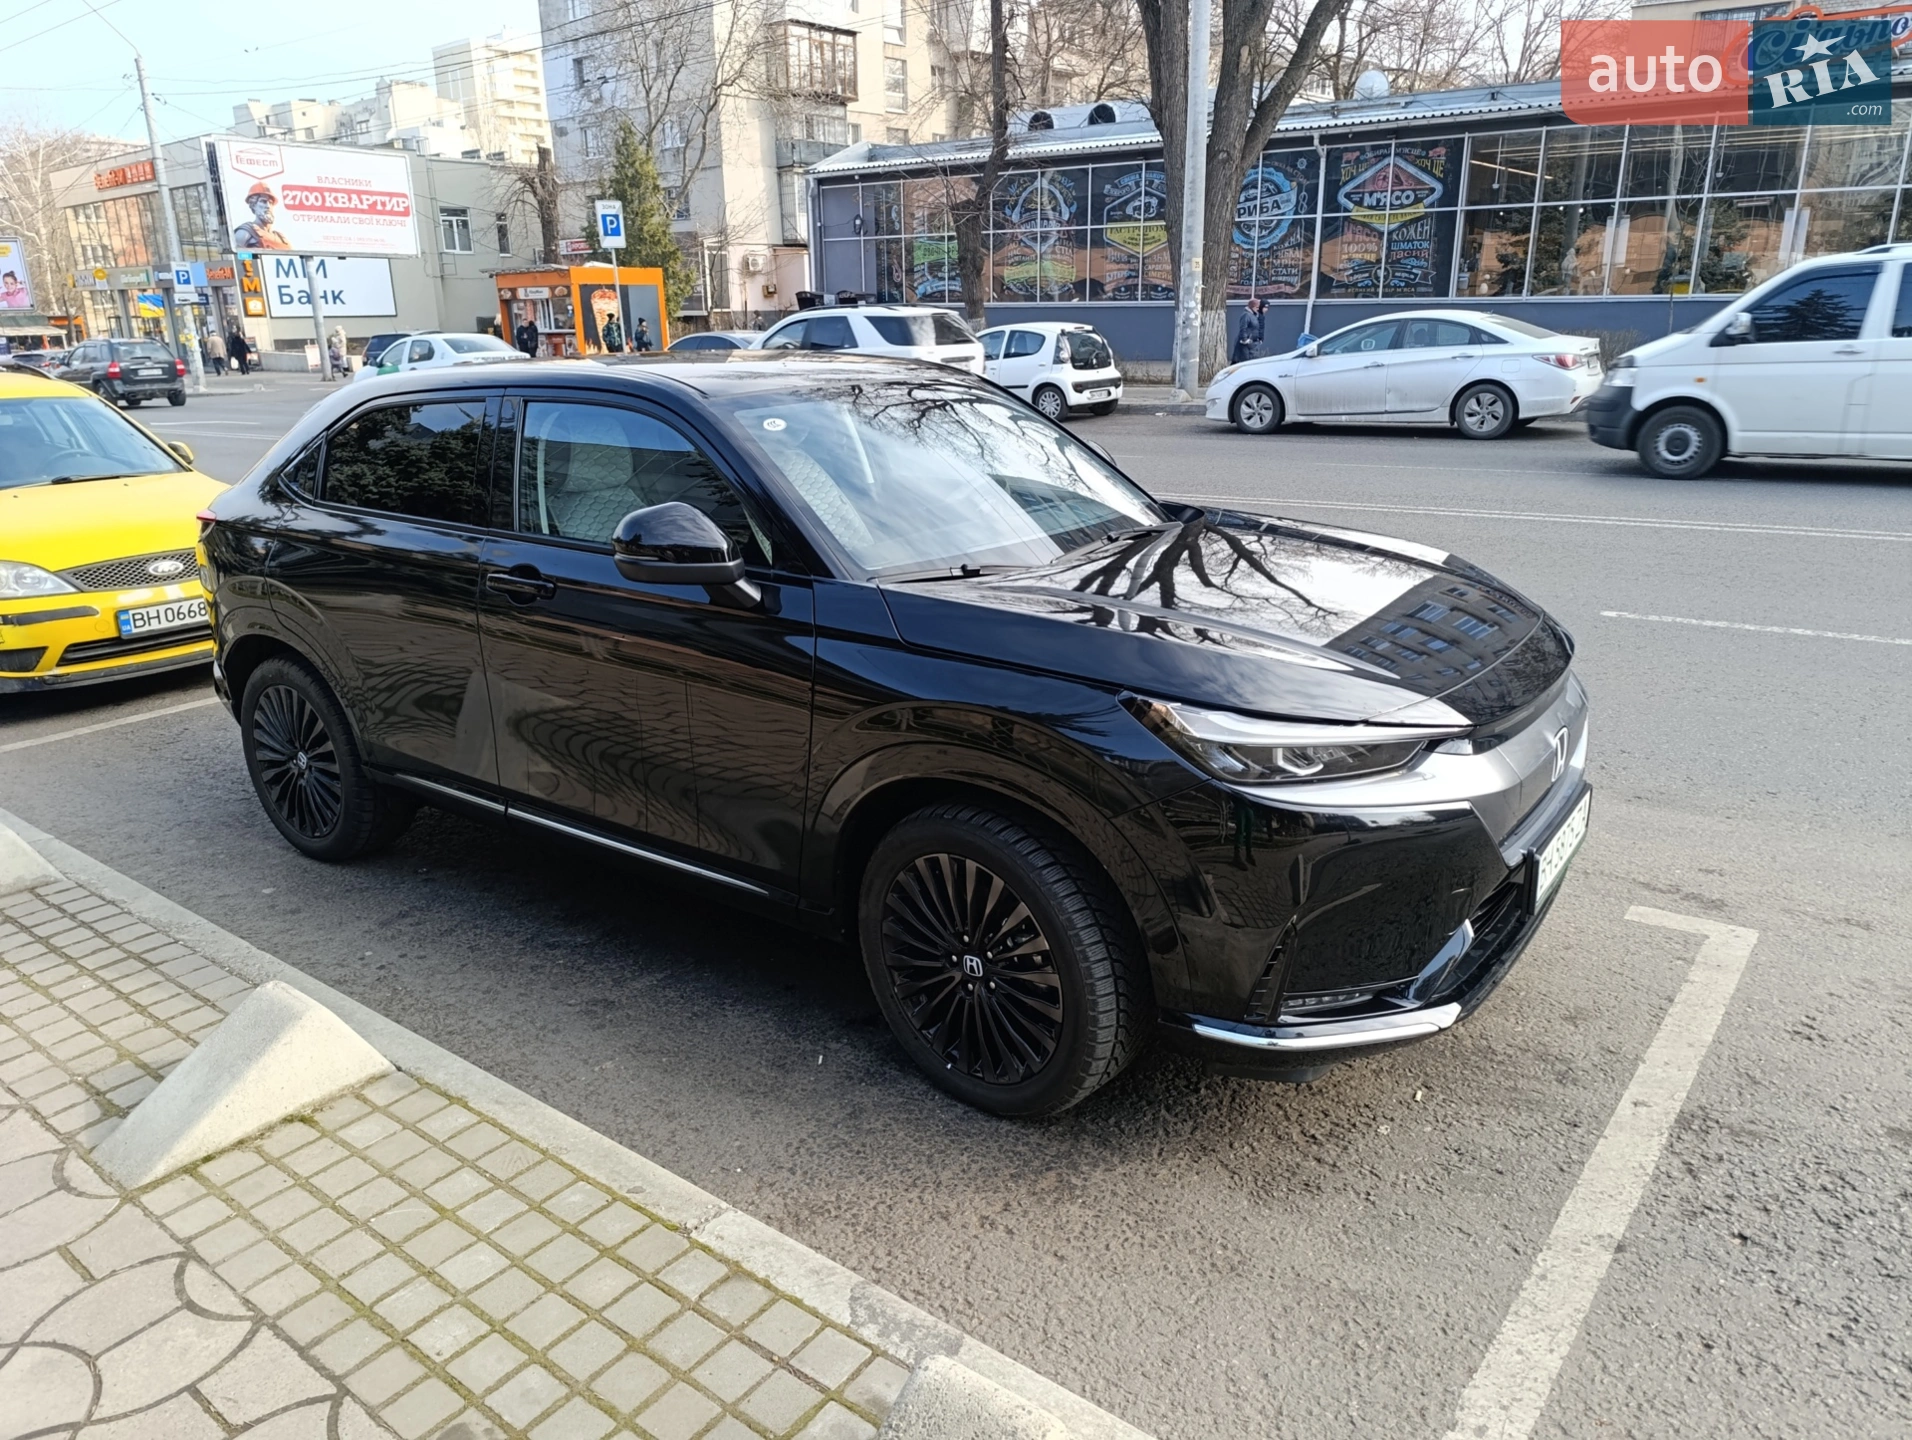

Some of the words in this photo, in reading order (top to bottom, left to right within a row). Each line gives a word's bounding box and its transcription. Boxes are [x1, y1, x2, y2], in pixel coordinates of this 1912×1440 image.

[1432, 160, 1445, 178] ЦЕ
[316, 175, 372, 187] ВЛАСНИКИ
[283, 189, 322, 207] 2700
[325, 192, 409, 212] КВАРТИР
[1363, 190, 1415, 207] М'ЯСО
[1236, 200, 1281, 217] РИБА
[293, 213, 350, 225] ОТРИМАЛИ
[353, 216, 374, 226] СВОЇ
[376, 217, 407, 228] КЛЮЧІ
[1392, 217, 1431, 241] КОЖЕН
[1341, 242, 1378, 254] 100%
[1390, 241, 1430, 250] ШМАТОК
[277, 285, 346, 305] Банк
[131, 609, 161, 629] BH
[164, 601, 208, 623] 0668
